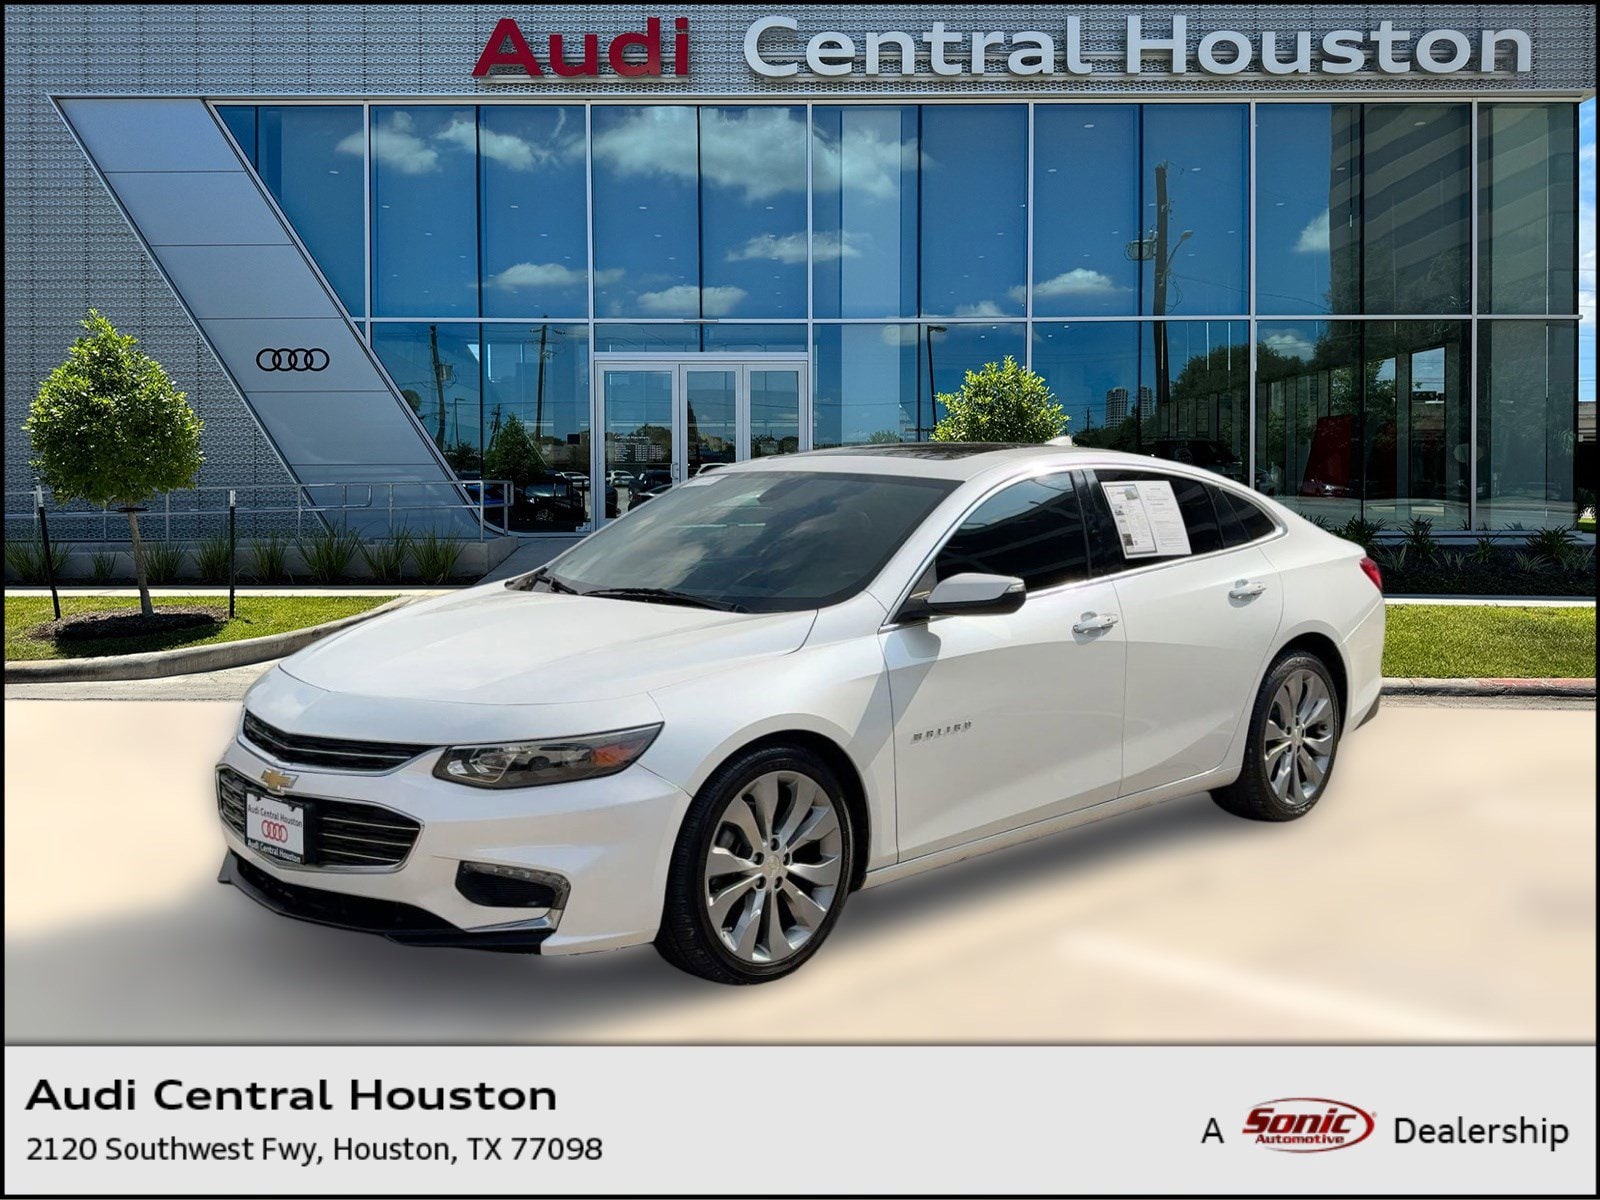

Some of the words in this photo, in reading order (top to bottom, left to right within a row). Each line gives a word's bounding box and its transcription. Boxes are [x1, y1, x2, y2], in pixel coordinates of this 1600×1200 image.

[472, 17, 691, 78] Audi
[743, 15, 1092, 78] Central
[1126, 14, 1534, 75] Houston
[912, 720, 973, 741] MALIBU
[247, 804, 259, 814] Audi
[260, 808, 280, 821] Central
[280, 814, 303, 828] Houston
[247, 839, 259, 849] Audi
[260, 843, 279, 856] Central
[279, 848, 301, 863] Houston
